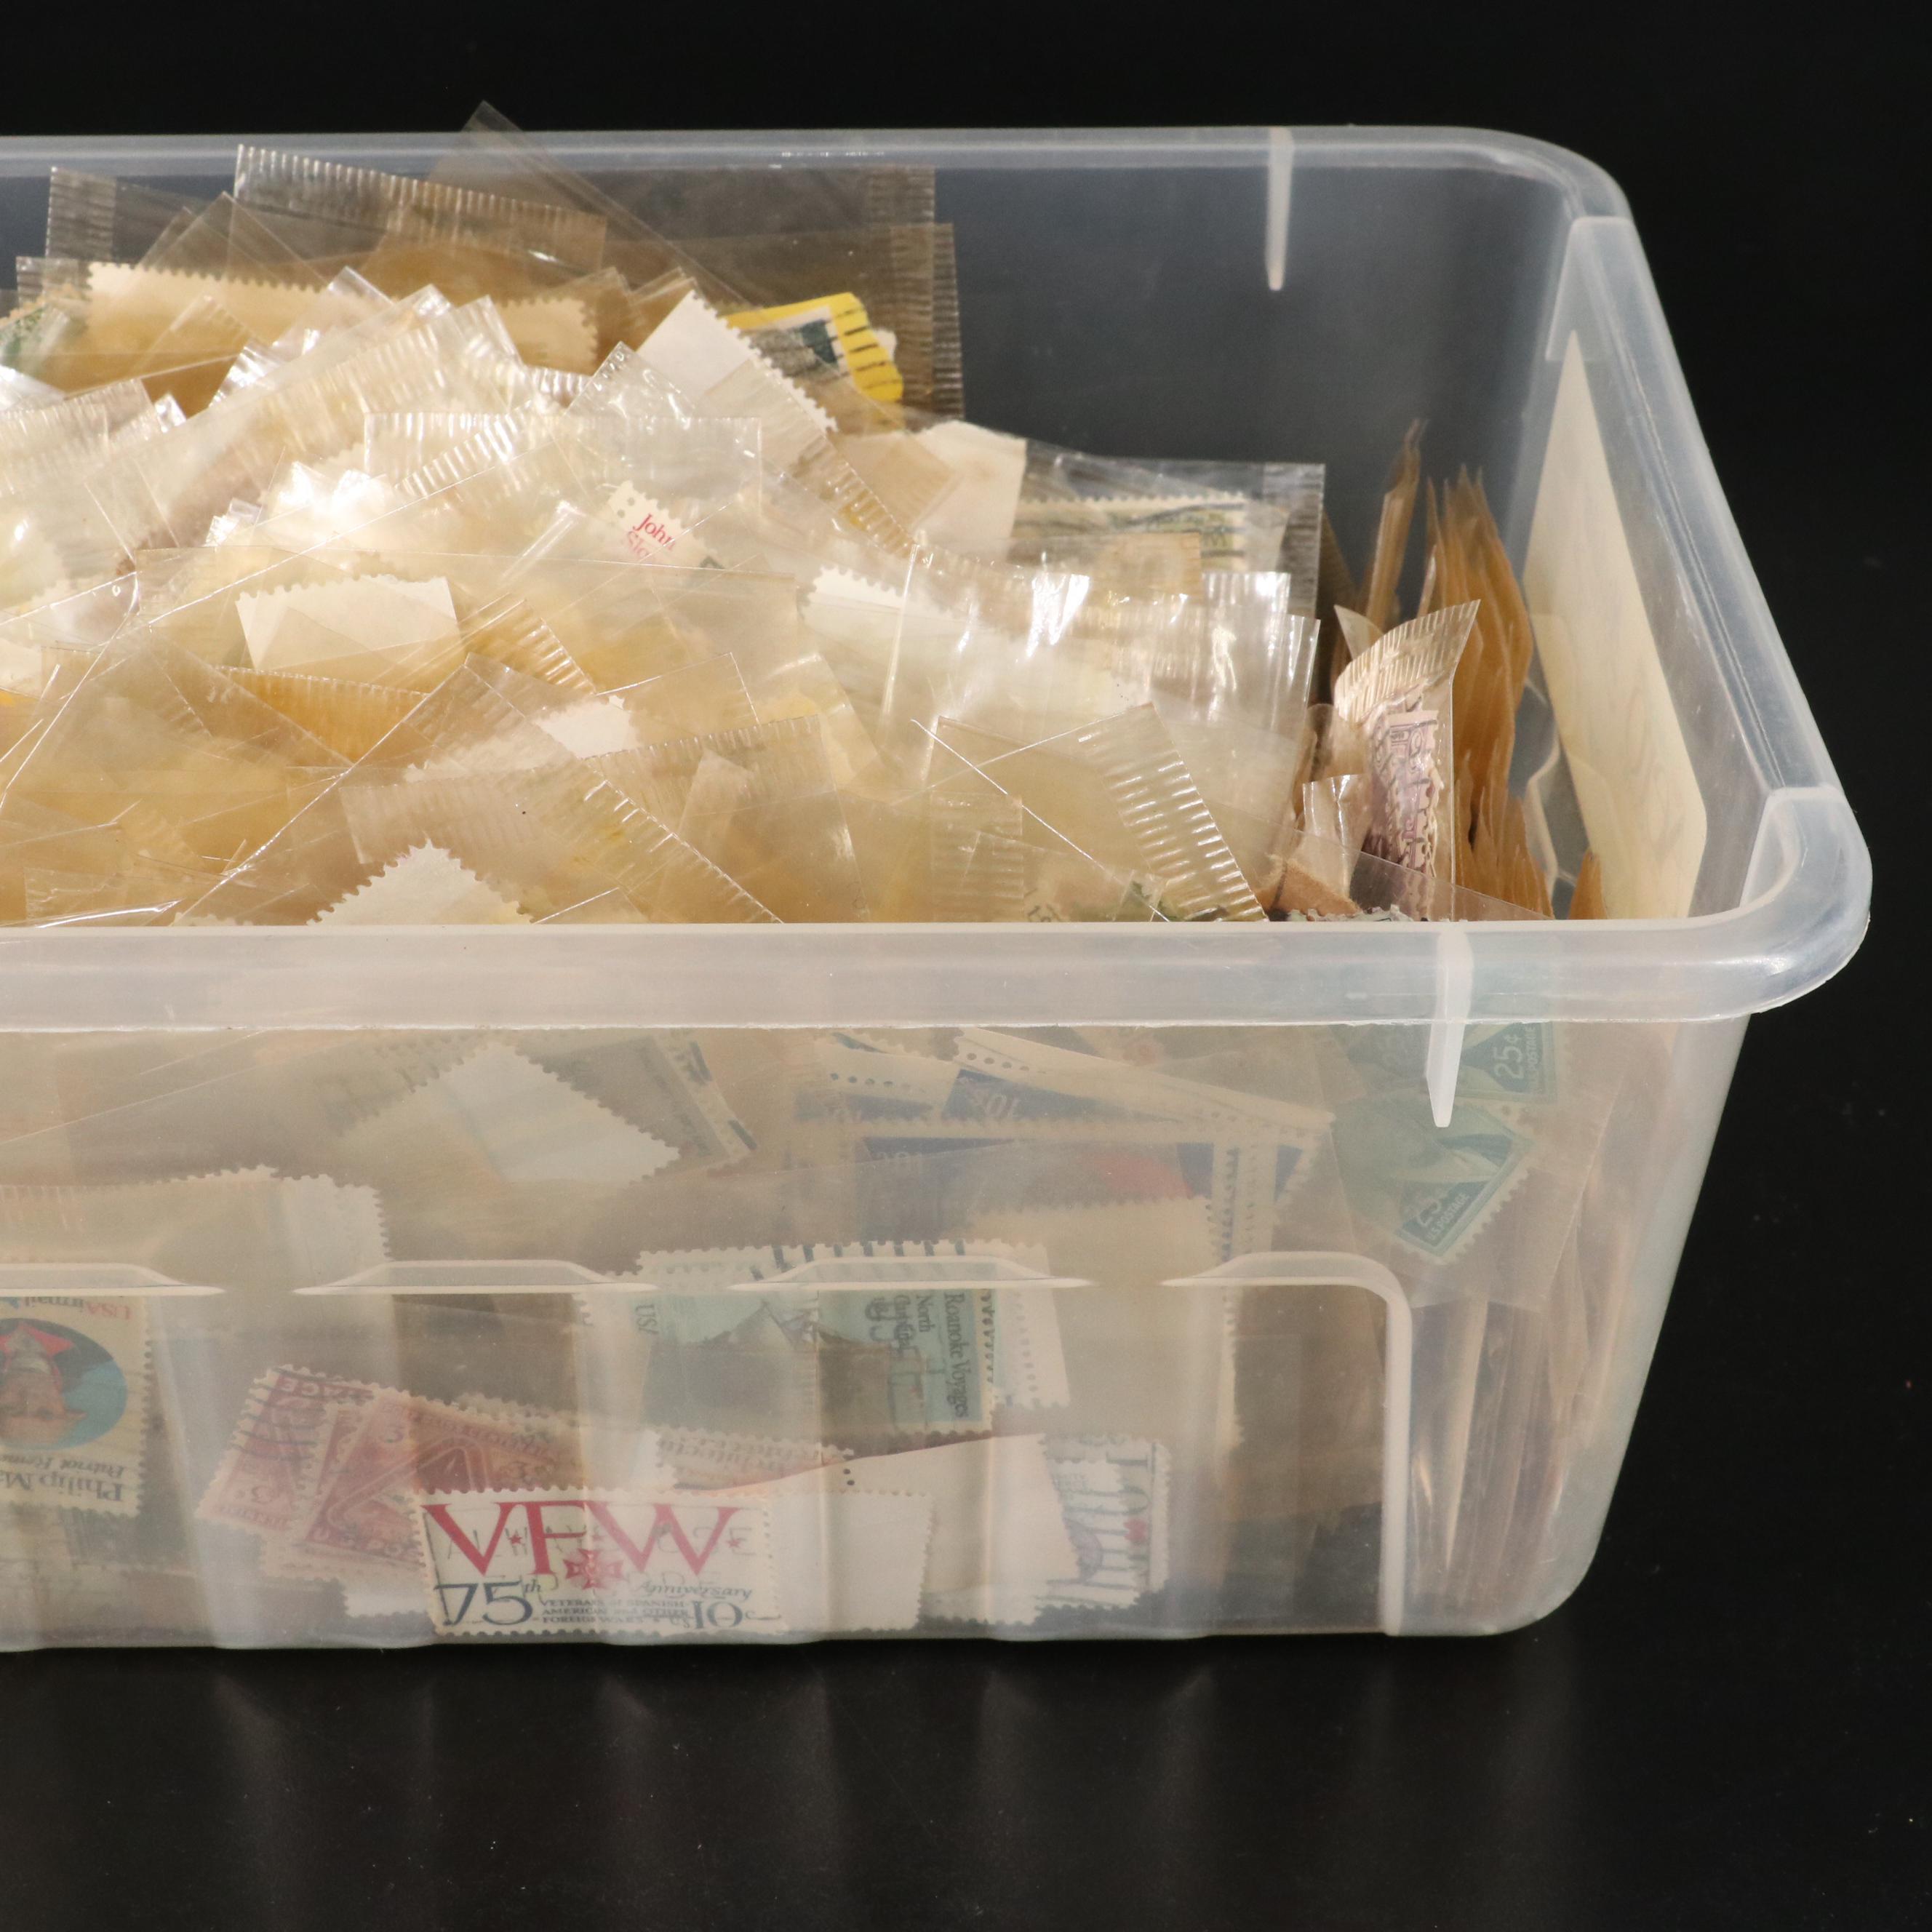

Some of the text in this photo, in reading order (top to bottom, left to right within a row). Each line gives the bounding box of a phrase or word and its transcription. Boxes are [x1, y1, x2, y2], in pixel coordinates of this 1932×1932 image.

[632, 514, 676, 551] John
[916, 1294, 936, 1333] North
[944, 1292, 971, 1418] Roanoke Voyages
[39, 1469, 124, 1503] Philip
[421, 1500, 741, 1577] VFW
[638, 1581, 754, 1600] Anniversary
